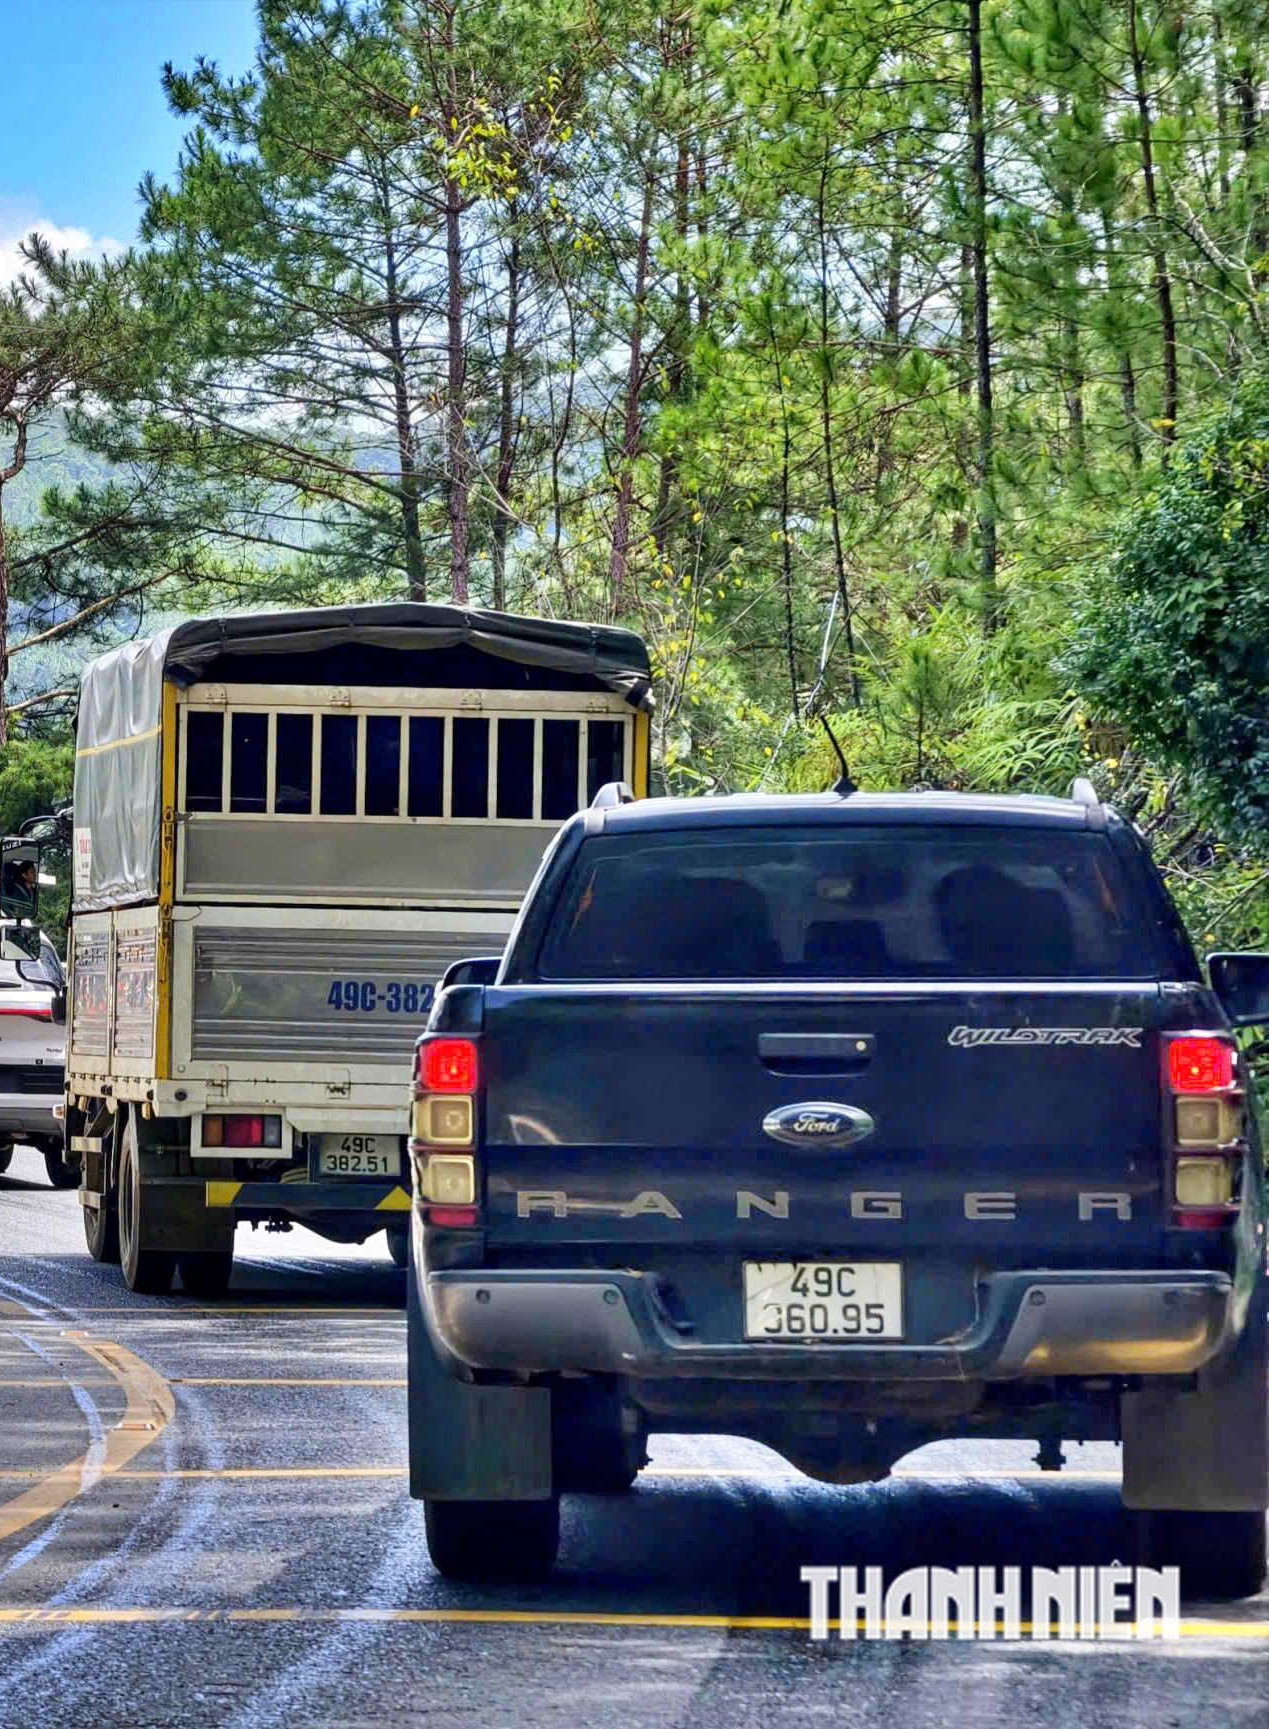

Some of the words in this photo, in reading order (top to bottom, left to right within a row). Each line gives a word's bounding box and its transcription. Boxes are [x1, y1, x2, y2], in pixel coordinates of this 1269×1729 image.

[947, 1025, 1142, 1048] WILDTRAK
[793, 1112, 841, 1134] Ford
[341, 1137, 376, 1153] 49C
[326, 1156, 388, 1173] 382.51
[517, 1191, 1132, 1221] RANGER
[790, 1266, 856, 1298] 49C
[763, 1303, 885, 1335] 360.95
